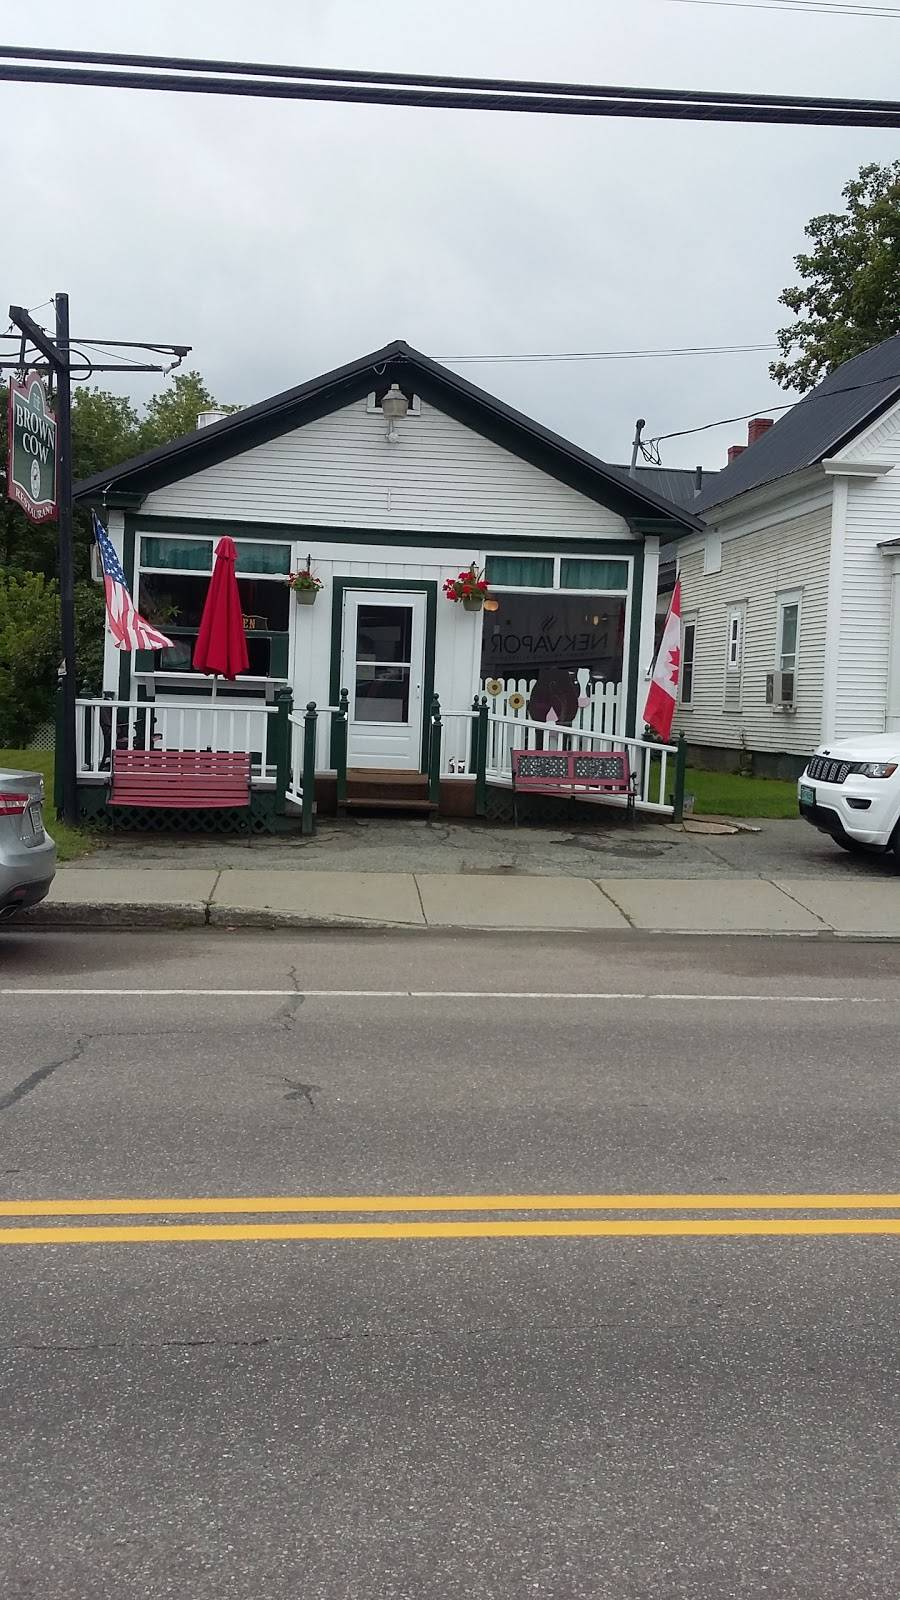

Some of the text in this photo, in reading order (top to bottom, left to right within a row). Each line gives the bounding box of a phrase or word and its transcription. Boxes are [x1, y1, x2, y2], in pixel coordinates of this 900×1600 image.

[16, 403, 55, 450] BROWN
[23, 432, 49, 465] COW
[15, 487, 53, 519] RESTAURANT
[243, 618, 256, 629] EN
